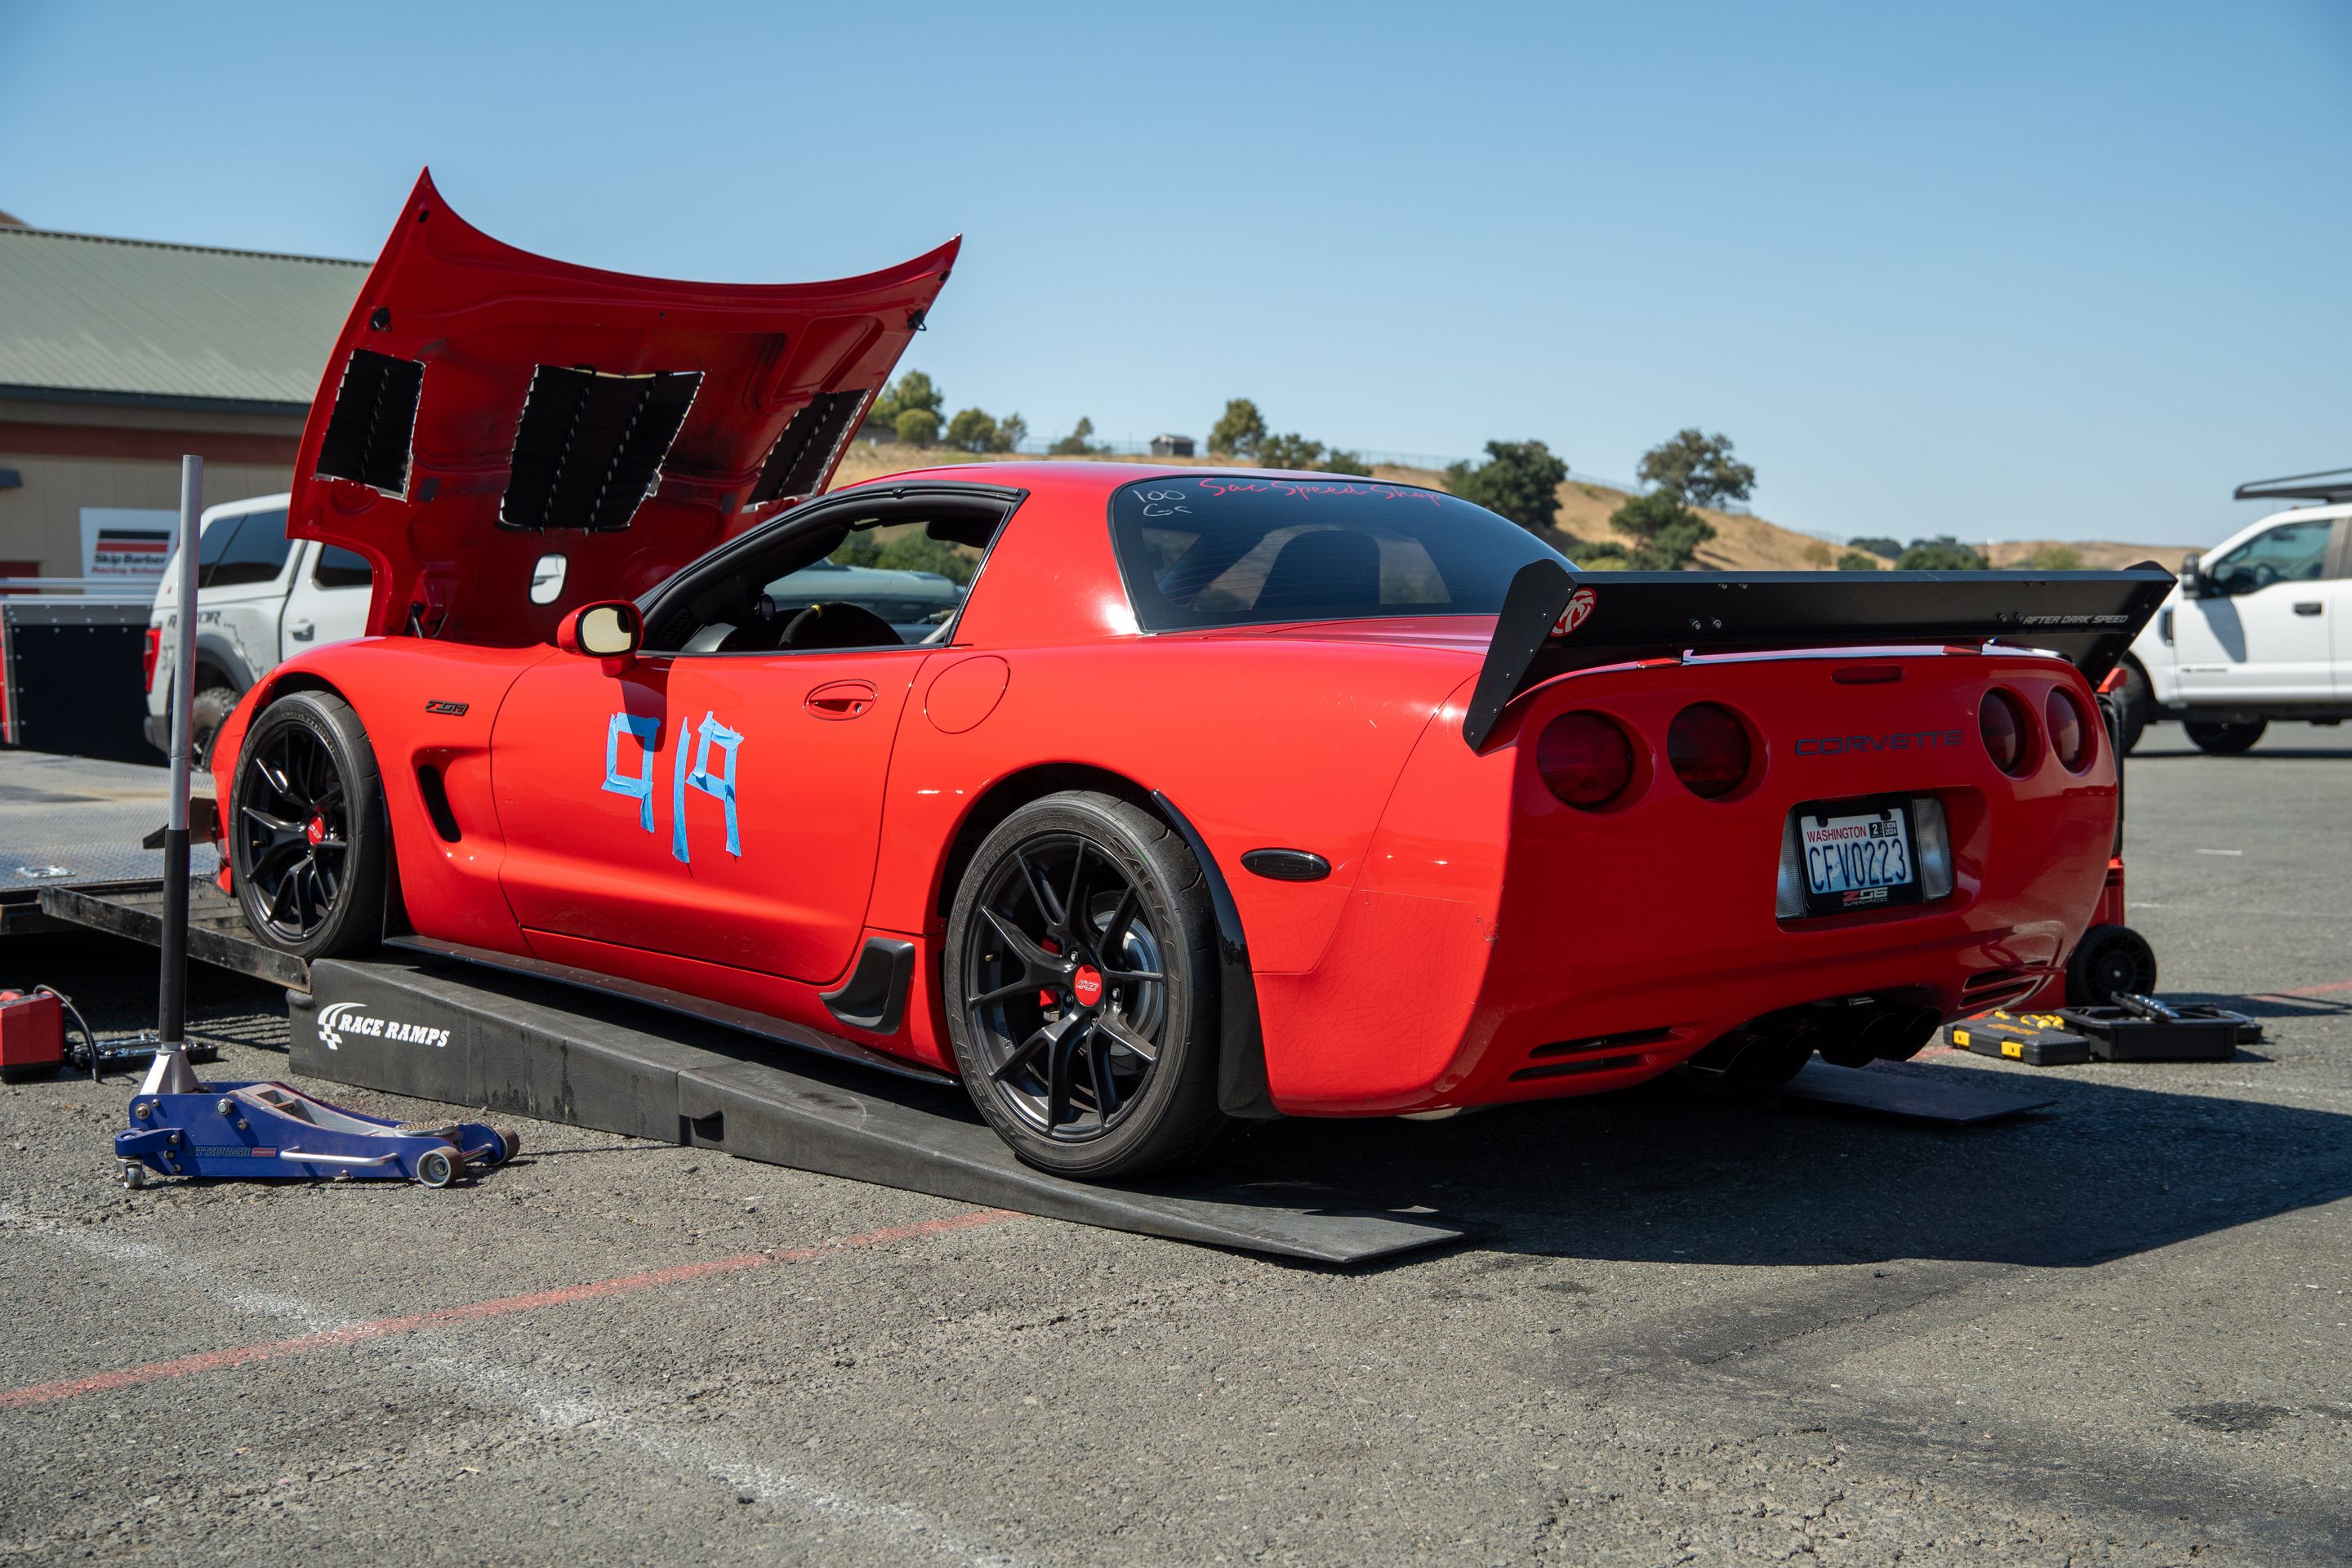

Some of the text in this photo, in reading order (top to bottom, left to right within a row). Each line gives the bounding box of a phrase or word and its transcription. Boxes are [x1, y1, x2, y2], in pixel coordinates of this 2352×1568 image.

[1133, 490, 1185, 502] 100
[1199, 479, 1441, 507] Sac Speed Shop
[93, 554, 167, 565] Skip Barber
[91, 567, 127, 575] Racing
[2022, 615, 2129, 625] AFTER DARK SPEED
[1795, 729, 1962, 756] CORVETTE
[1806, 825, 1867, 843] WASHINGTON
[1872, 823, 1879, 835] 2
[1809, 838, 1906, 891] CFV0223
[1842, 886, 1888, 902] Z06
[338, 1013, 451, 1047] RACE RAMPS
[188, 1147, 252, 1156] PITTSBURGH
